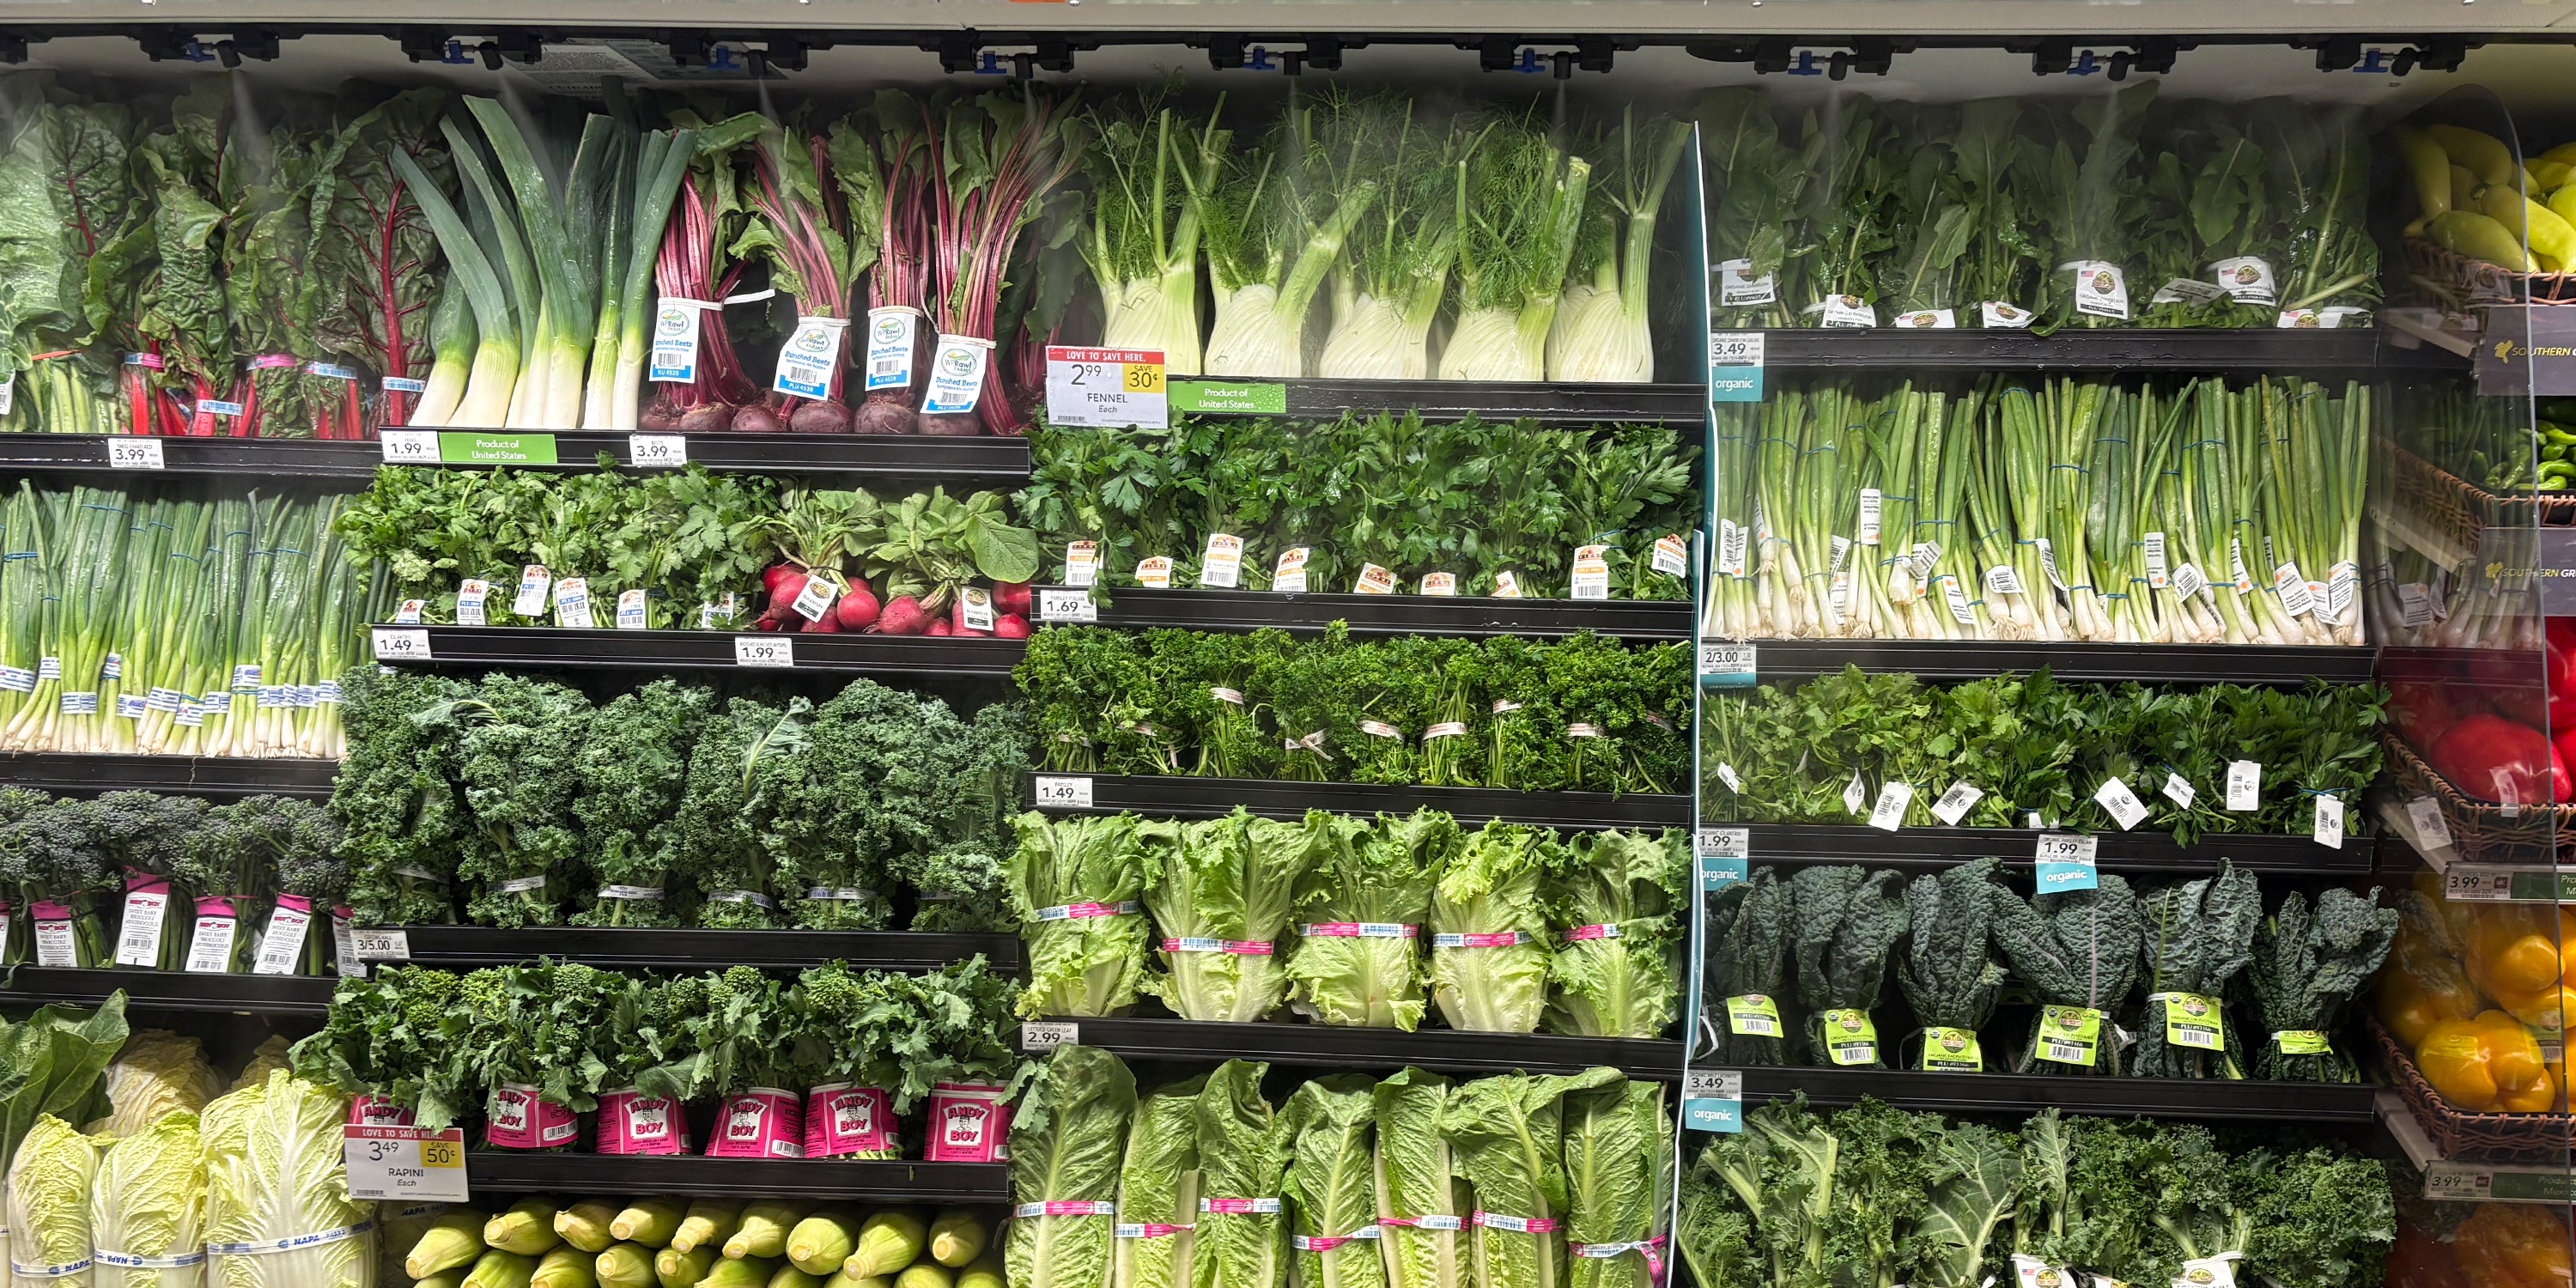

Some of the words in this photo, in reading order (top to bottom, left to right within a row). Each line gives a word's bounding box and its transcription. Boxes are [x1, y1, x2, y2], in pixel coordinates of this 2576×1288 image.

[871, 348, 891, 356] Bunched
[1713, 343, 1747, 355] 3.49
[785, 350, 811, 361] Bunched
[812, 356, 830, 367] Beets
[1066, 350, 1087, 361] LOVE
[1089, 351, 1100, 361] TO
[1103, 352, 1121, 362] SAVE
[1124, 353, 1146, 362] HERE.
[1133, 365, 1153, 374] SAVE
[788, 382, 799, 391] PLU
[799, 384, 814, 393] 4539
[935, 377, 962, 386] Bunched
[1715, 377, 1754, 392] organic
[1086, 392, 1128, 404] FENNEL
[1205, 388, 1238, 398] Product
[1239, 387, 1249, 398] of
[1098, 404, 1118, 414] Each
[1199, 399, 1227, 410] United
[1228, 400, 1255, 410] States
[391, 443, 422, 454] 1.99
[476, 439, 509, 449] Product
[509, 439, 520, 448] of
[115, 448, 145, 460] 3.99
[471, 451, 500, 459] United
[501, 451, 527, 460] States
[636, 446, 668, 457] 3.99
[2501, 568, 2559, 578] SOUTHERN
[1047, 600, 1078, 612] 1.69
[380, 639, 411, 651] 1.49
[742, 647, 774, 659] 1.99
[1704, 652, 1738, 663] 2/3.00
[1042, 787, 1074, 799] 1.49
[1699, 835, 1731, 847] 1.99
[2044, 841, 2078, 854] 1.99
[1701, 867, 1739, 882] organic
[2045, 869, 2088, 884] organic
[2561, 874, 2576, 884] Pro
[2449, 877, 2480, 889] 3.99
[357, 939, 391, 951] 3/5.00
[1027, 1031, 1060, 1043] 2.99
[1691, 1077, 1724, 1089] 3.49
[629, 1099, 667, 1114] ANDY
[732, 1103, 763, 1115] ANDY
[835, 1097, 873, 1111] ANDY
[364, 1106, 401, 1119] ANDY
[947, 1106, 986, 1121] ANDY
[1693, 1109, 1733, 1122] organic
[499, 1115, 522, 1127] BOY
[840, 1119, 867, 1133] BOY
[362, 1128, 382, 1137] LOVE
[386, 1129, 396, 1138] TO
[398, 1130, 418, 1139] SAVE
[635, 1121, 664, 1135] BOY
[730, 1125, 756, 1137] BOY
[950, 1130, 979, 1142] BOY
[388, 1168, 424, 1177] RAPINI
[2432, 1176, 2462, 1187] 3.99
[402, 1206, 426, 1217] NAPA
[294, 1234, 320, 1246] NAPA
[64, 1259, 90, 1273] NAPA
[107, 1255, 128, 1265] NAPA
